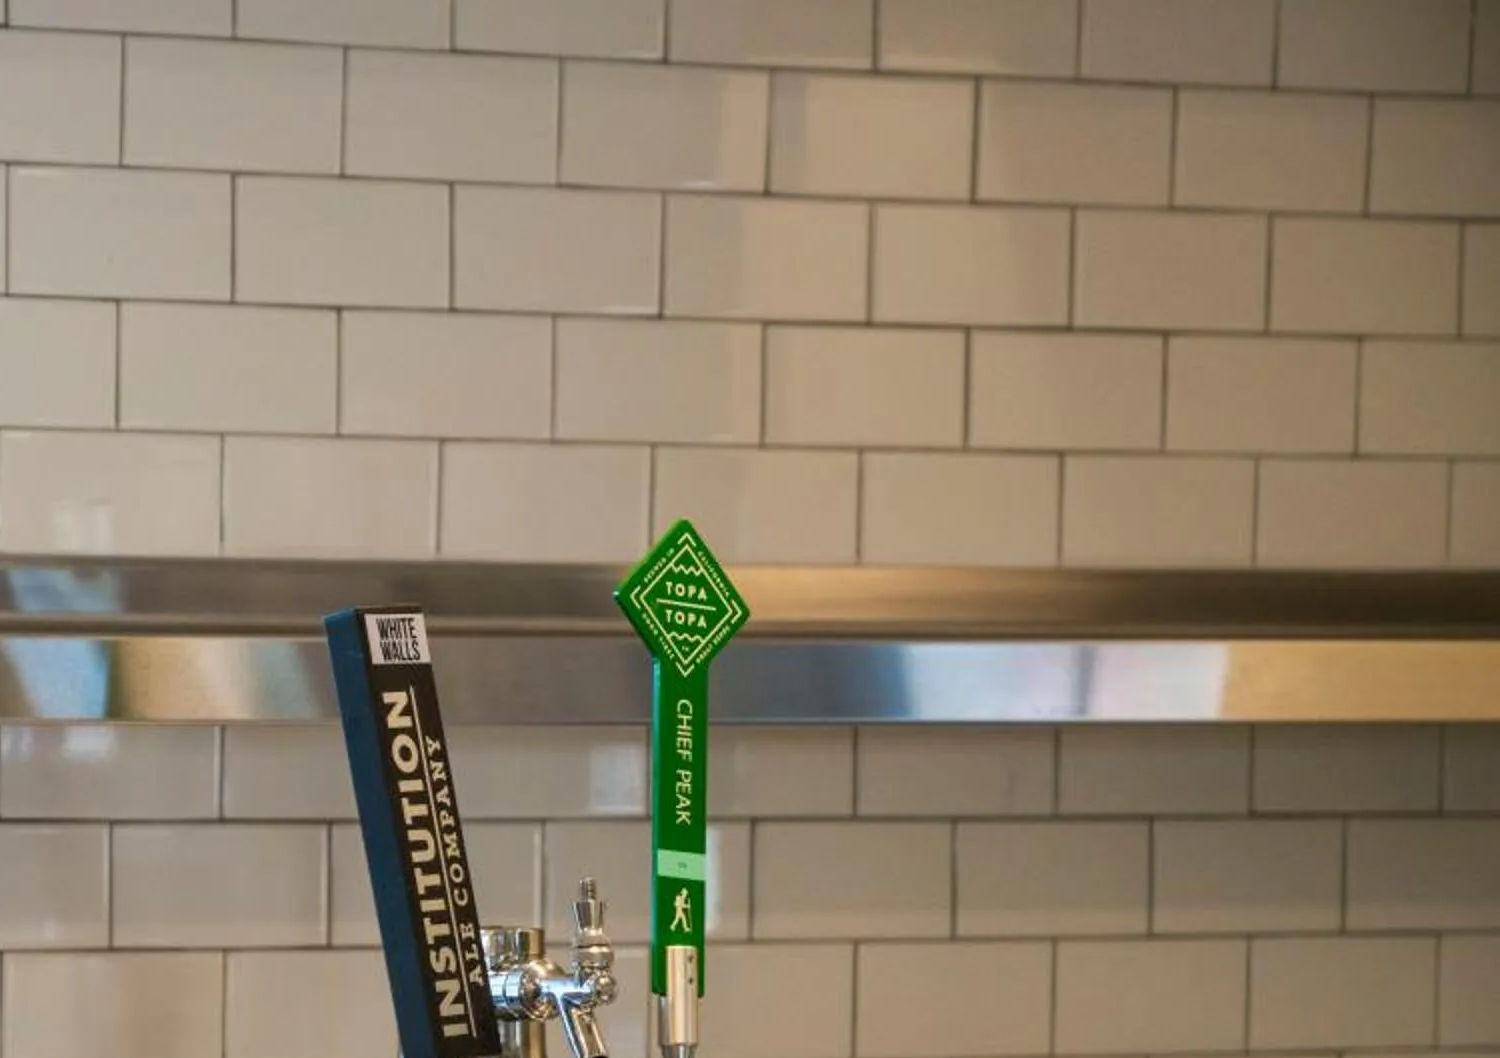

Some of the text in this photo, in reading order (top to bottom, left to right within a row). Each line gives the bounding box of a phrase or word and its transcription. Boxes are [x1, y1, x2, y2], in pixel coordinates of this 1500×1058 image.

[665, 581, 708, 601] TOPA
[376, 617, 417, 639] WHITE
[665, 609, 707, 628] TOPA
[380, 639, 421, 661] WALLS
[675, 698, 694, 826] CHIEF PEAK
[382, 690, 468, 1038] INSTITUTION
[425, 736, 484, 988] ALE COMPANY
